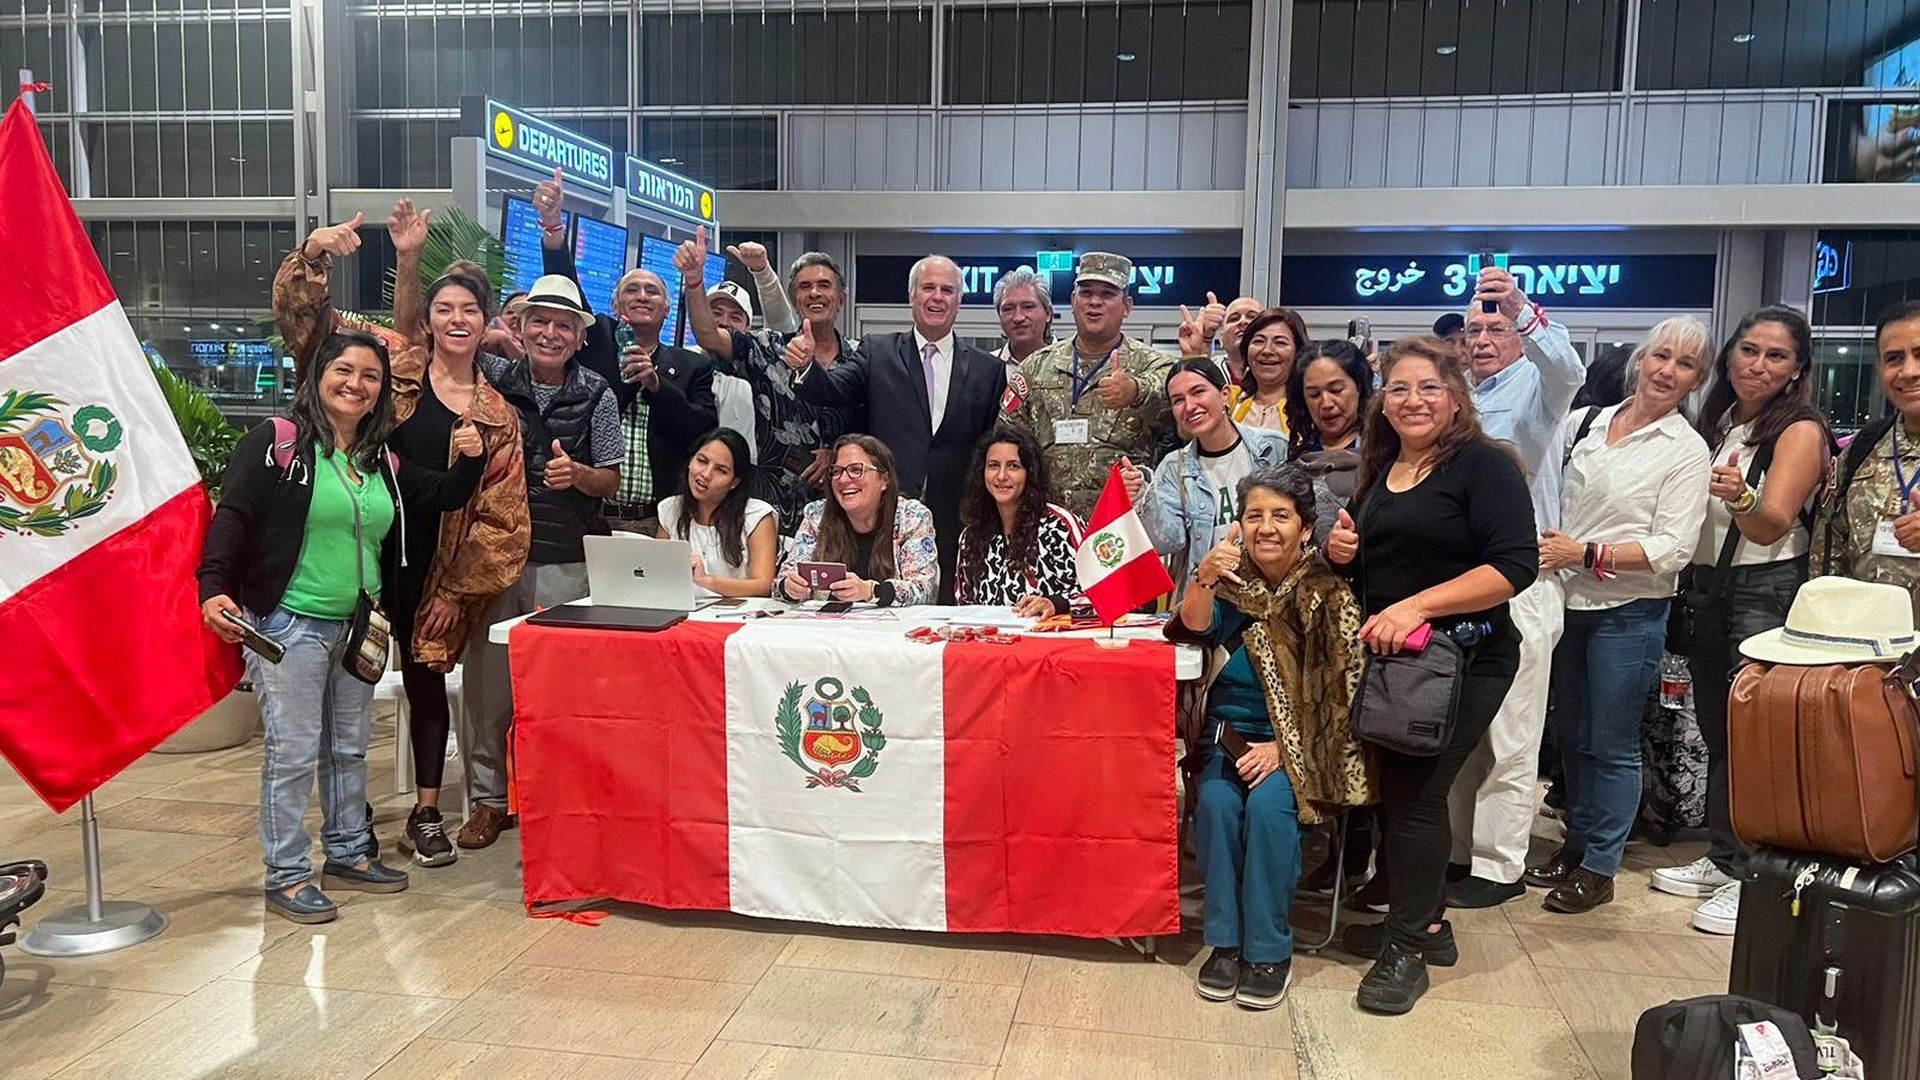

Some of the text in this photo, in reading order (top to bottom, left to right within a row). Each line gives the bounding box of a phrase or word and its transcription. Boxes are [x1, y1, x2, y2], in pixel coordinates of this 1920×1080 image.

[519, 123, 608, 180] DEPARTURES
[638, 170, 694, 210] המראות
[961, 266, 999, 293] XIT
[1355, 261, 1426, 297] خروج
[1443, 264, 1620, 296] יציאה 3
